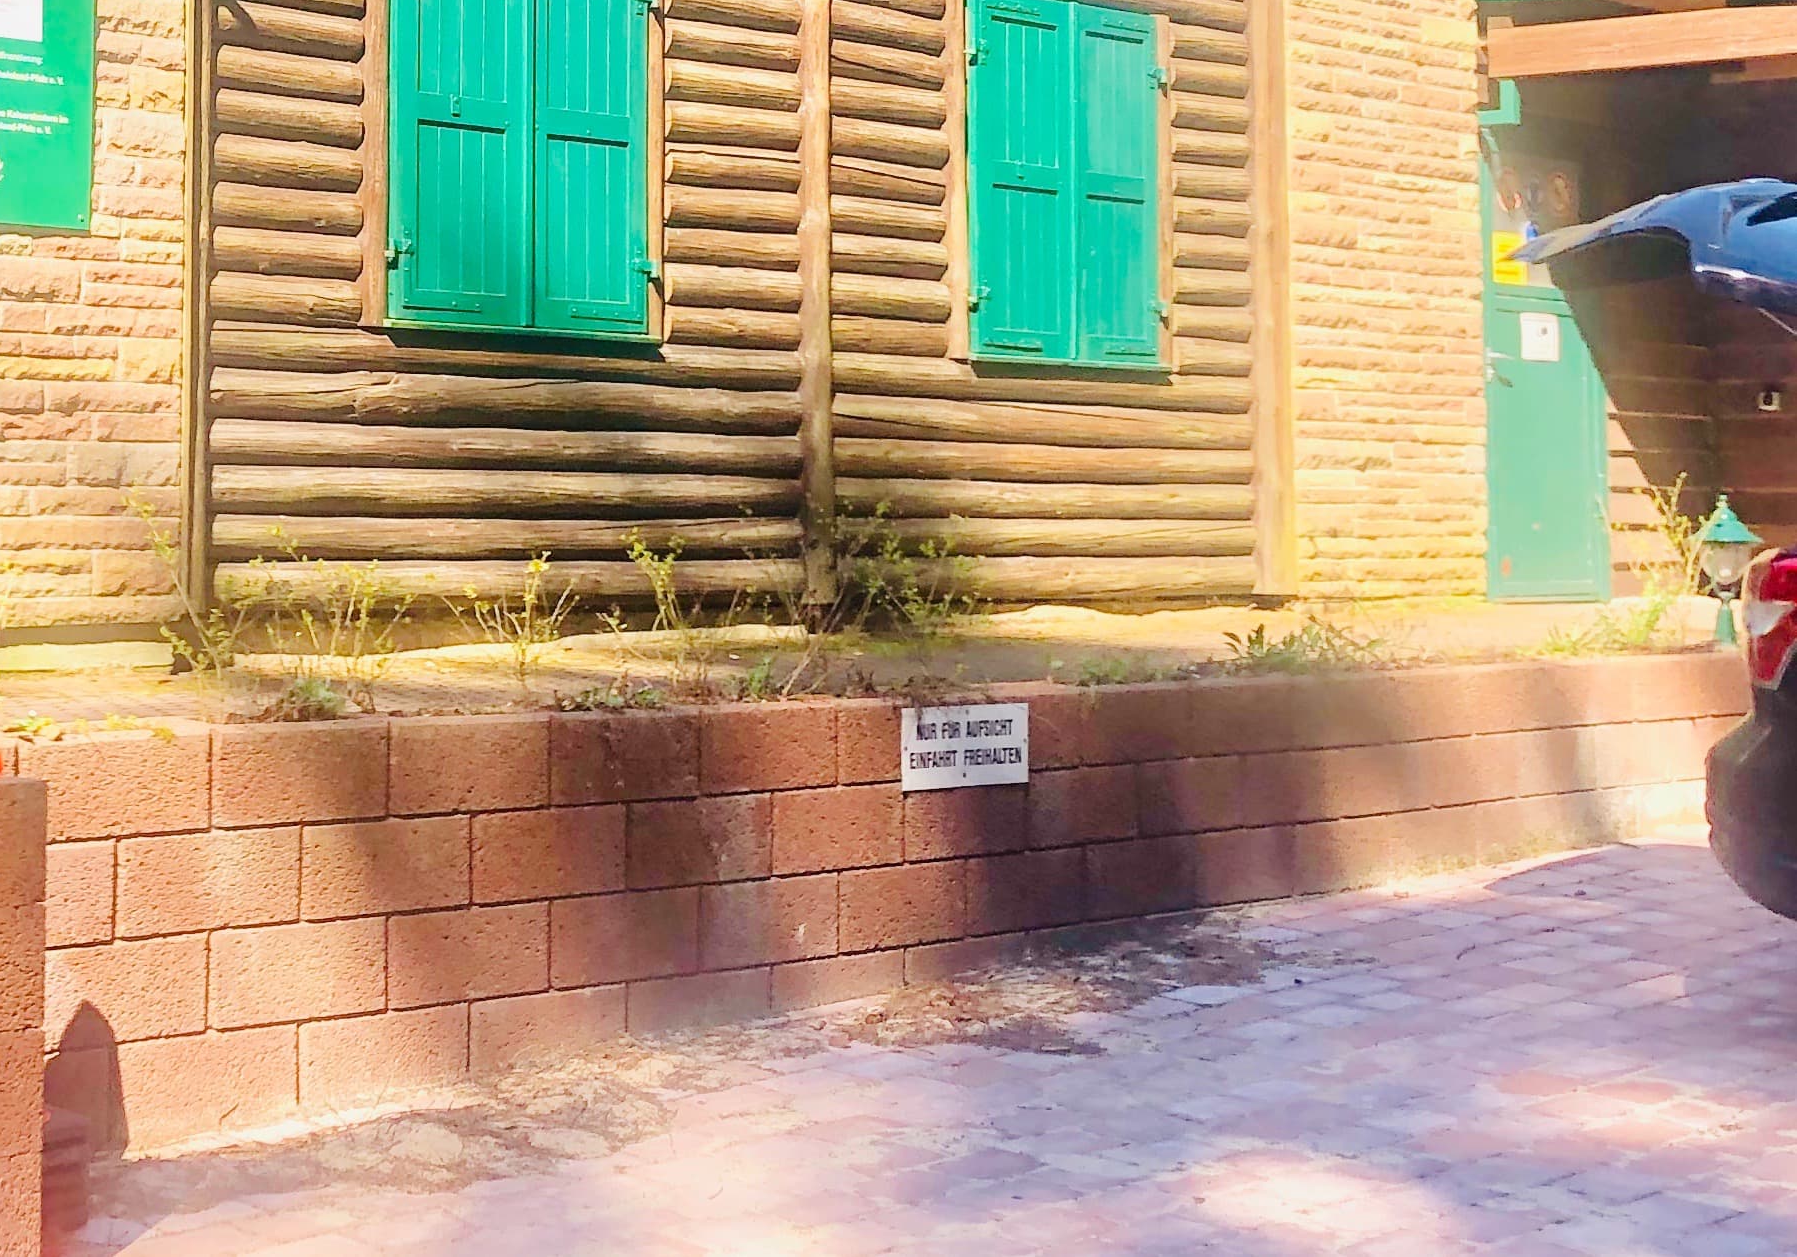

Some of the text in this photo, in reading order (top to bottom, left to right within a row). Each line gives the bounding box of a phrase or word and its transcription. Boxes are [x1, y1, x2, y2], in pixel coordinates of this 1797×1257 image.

[917, 718, 1014, 740] NUR FÜR AUFSICHT
[909, 746, 1023, 770] EINFAHRT FREIHALTEN
